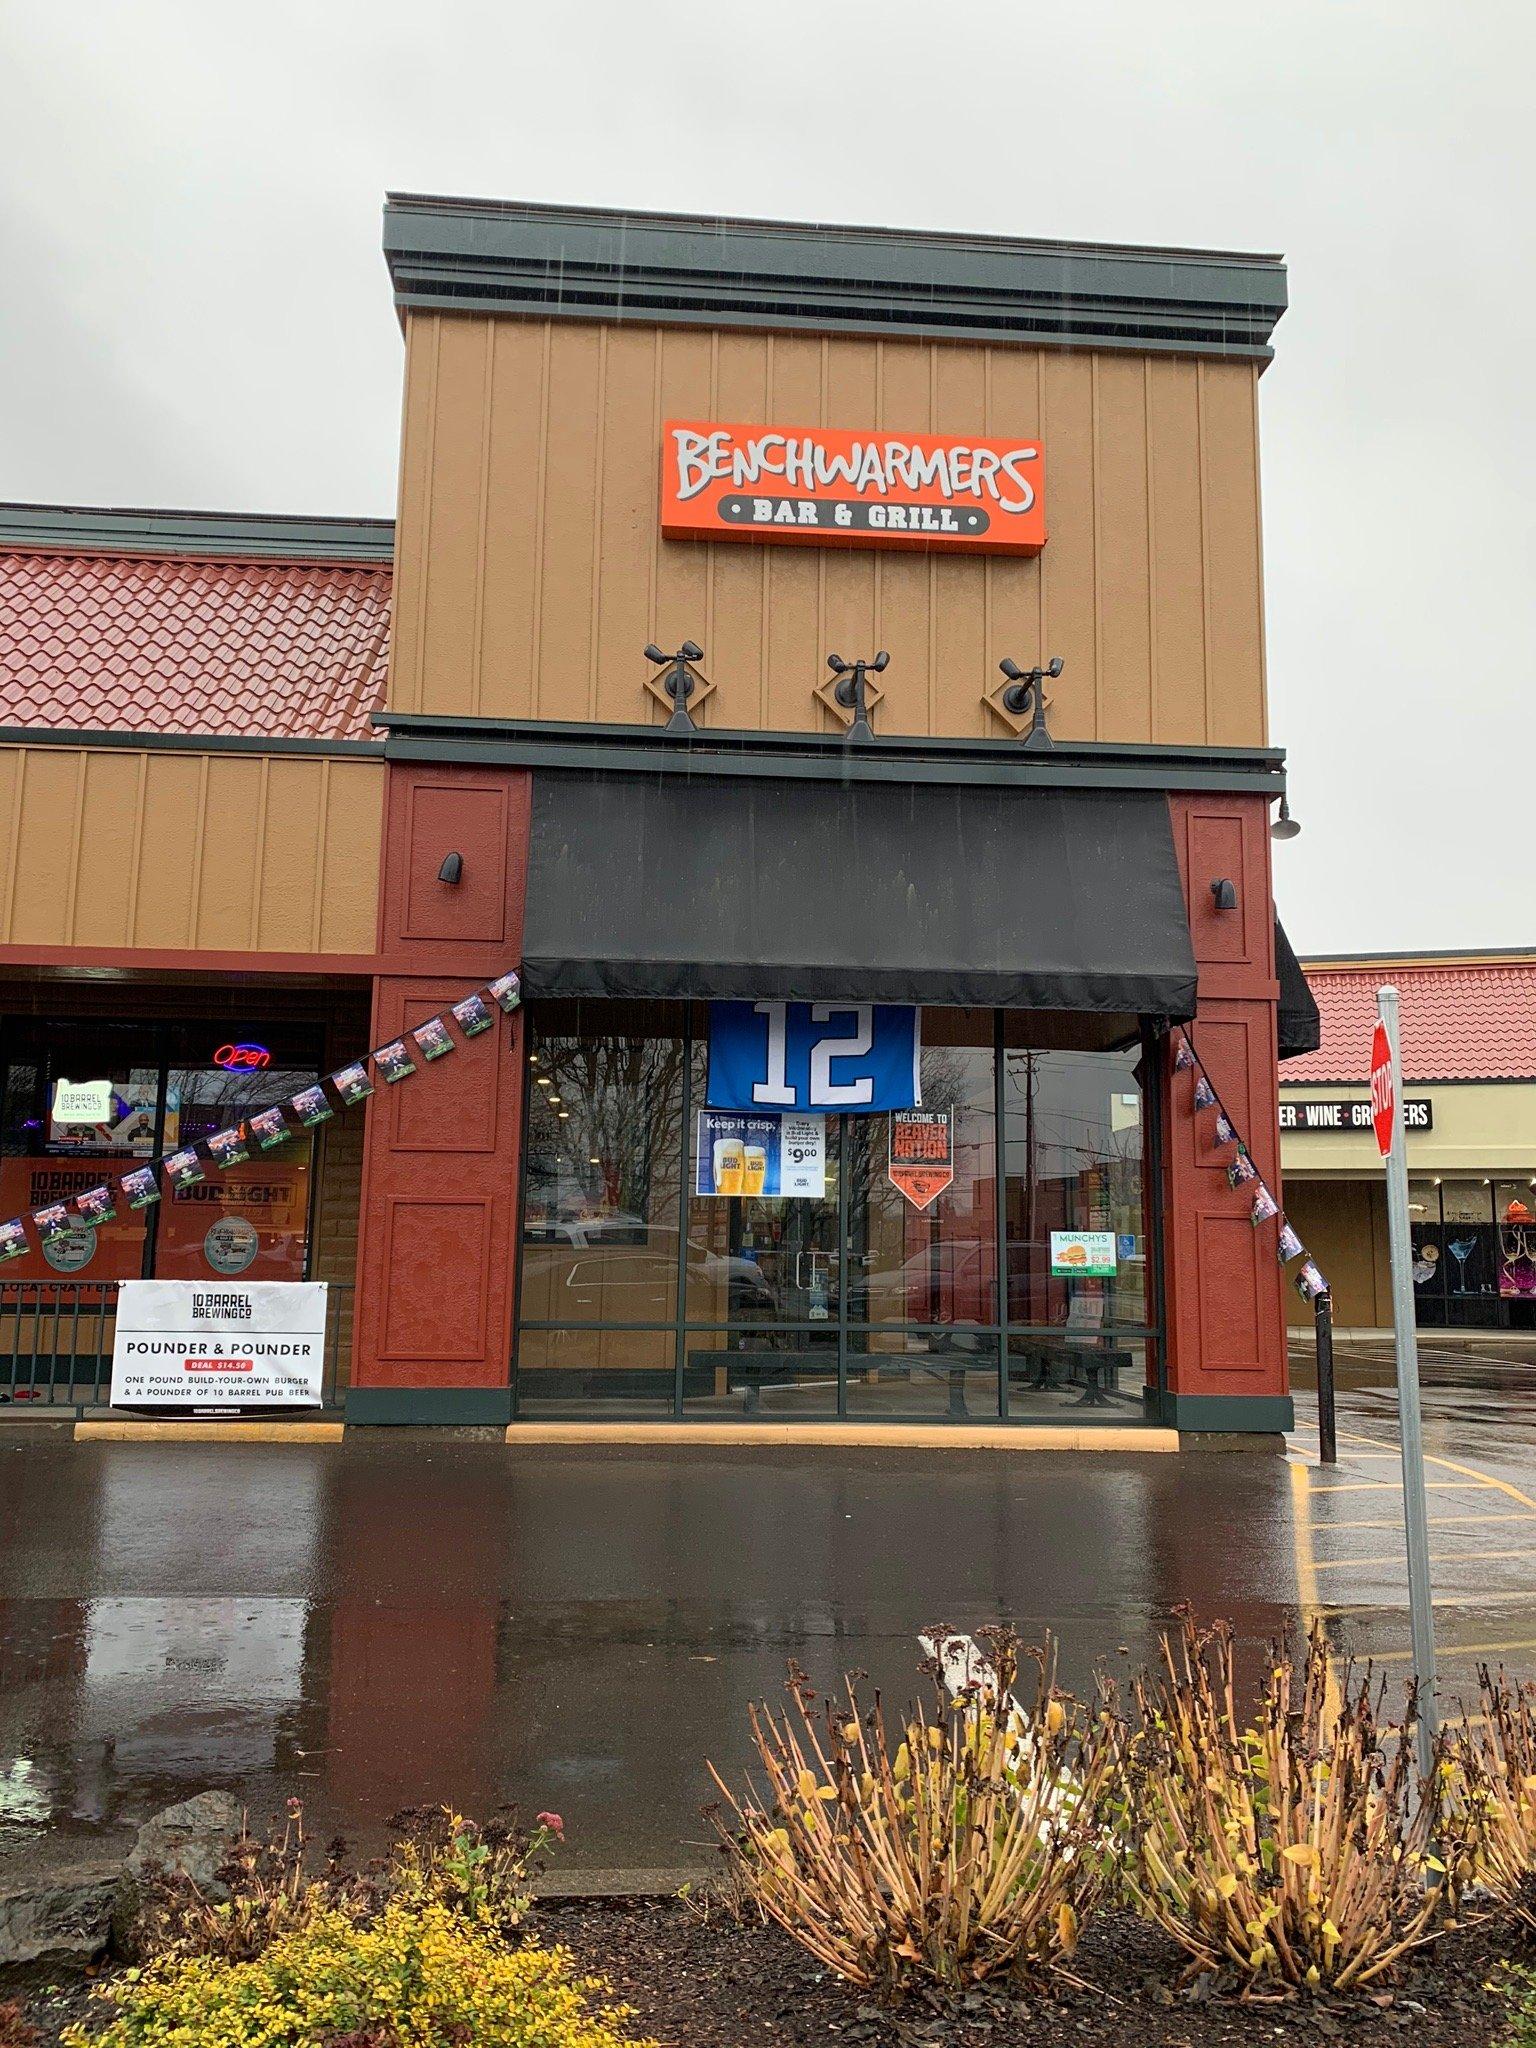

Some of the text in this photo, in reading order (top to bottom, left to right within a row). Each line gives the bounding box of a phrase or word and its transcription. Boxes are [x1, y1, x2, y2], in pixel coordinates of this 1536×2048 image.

[671, 428, 1038, 514] BENCHWARMERS
[752, 498, 959, 531] BAR & GRILL
[213, 1044, 270, 1067] Open
[752, 1001, 874, 1105] 12
[1370, 1062, 1393, 1117] STOP
[895, 1112, 947, 1124] WELCOME TO
[1279, 1104, 1429, 1126] ER WINE GRERS
[706, 1119, 776, 1132] Keep it crisp.
[894, 1123, 947, 1140] BEAVER
[894, 1140, 947, 1159] NATION
[1059, 1234, 1108, 1243] MUNCHYS
[205, 1294, 252, 1308] BARREL
[126, 1342, 311, 1356] POUNDER & POUNDER
[191, 1361, 247, 1370] DEAL $14.50
[125, 1376, 309, 1385] ONE POUND BUILD-YOUR-OWN BURGER
[124, 1388, 310, 1397] & A POUNDER OF 10 BARREL PUB BEER
